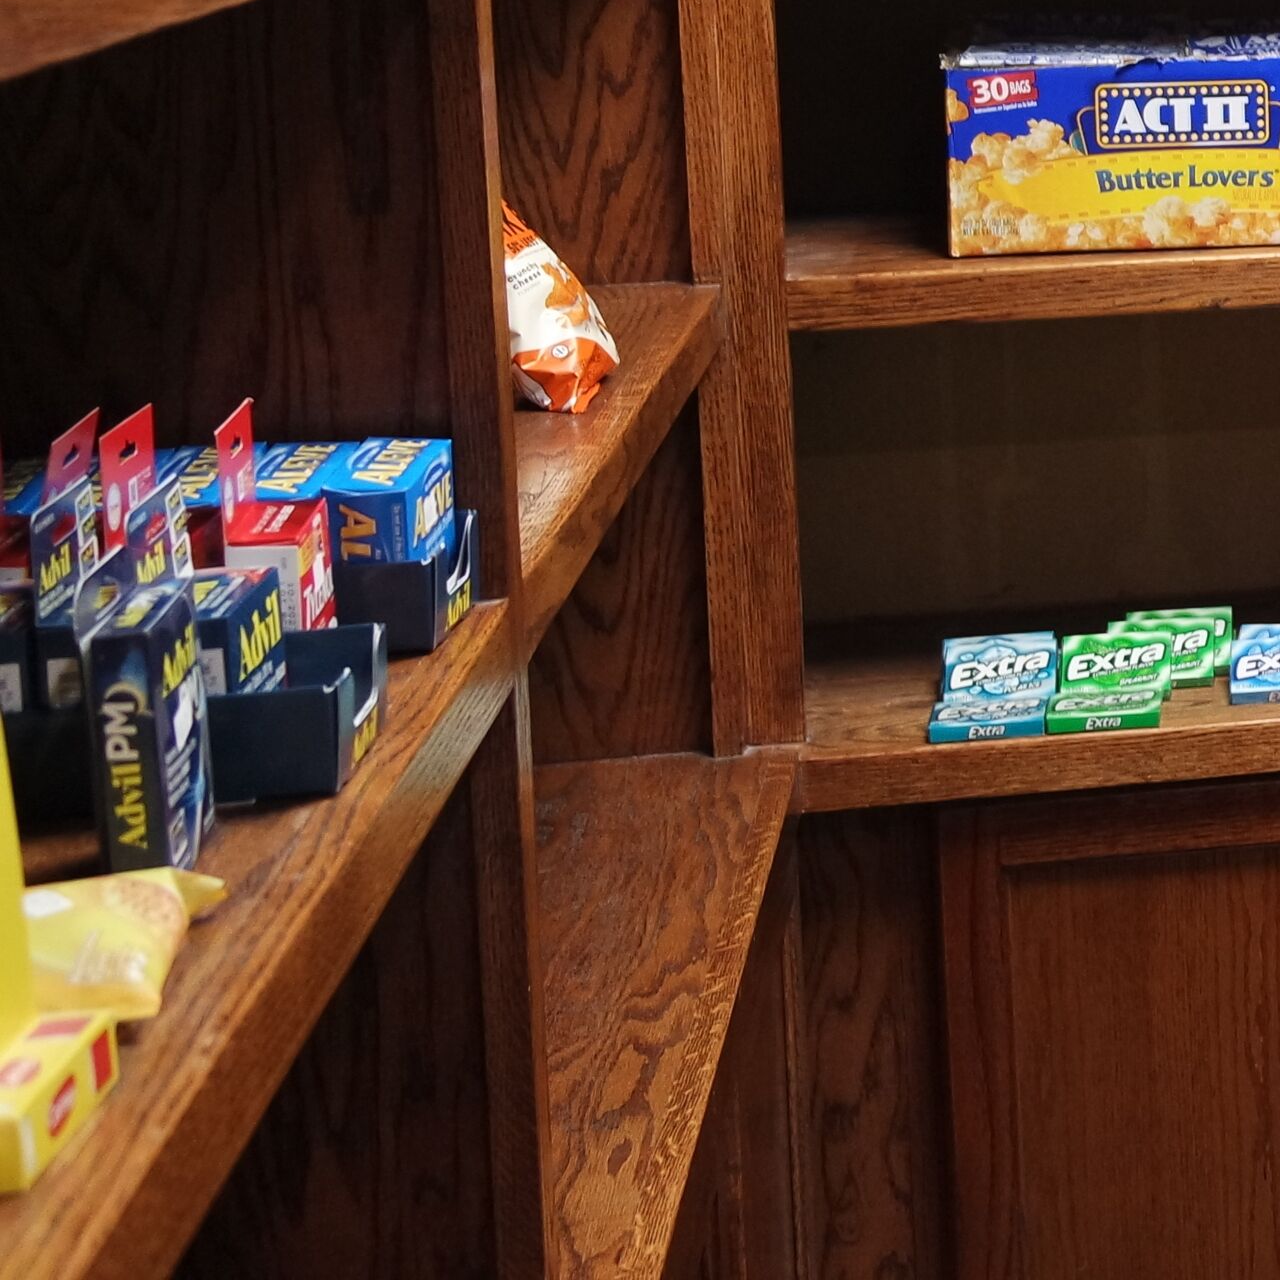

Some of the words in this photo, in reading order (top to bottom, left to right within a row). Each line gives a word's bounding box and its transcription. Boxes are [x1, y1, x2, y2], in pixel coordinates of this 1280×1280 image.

[972, 77, 1009, 104] 30
[1009, 79, 1031, 96] BAGS
[1114, 97, 1195, 135] ACT
[1202, 95, 1250, 132] II
[1095, 168, 1183, 194] Butter
[1188, 166, 1275, 189] Lovers
[256, 442, 338, 494] ALEVE
[352, 438, 432, 486] ALEVE
[238, 590, 282, 683] Advil
[162, 623, 197, 699] Advil
[950, 650, 1051, 691] Extra
[1067, 642, 1166, 682] Extra
[938, 697, 1041, 721] Extra
[1054, 690, 1155, 712] Extra
[102, 699, 141, 762] PM
[968, 723, 1006, 740] Extra
[1085, 716, 1122, 731] Extra
[110, 762, 148, 850] Advil
